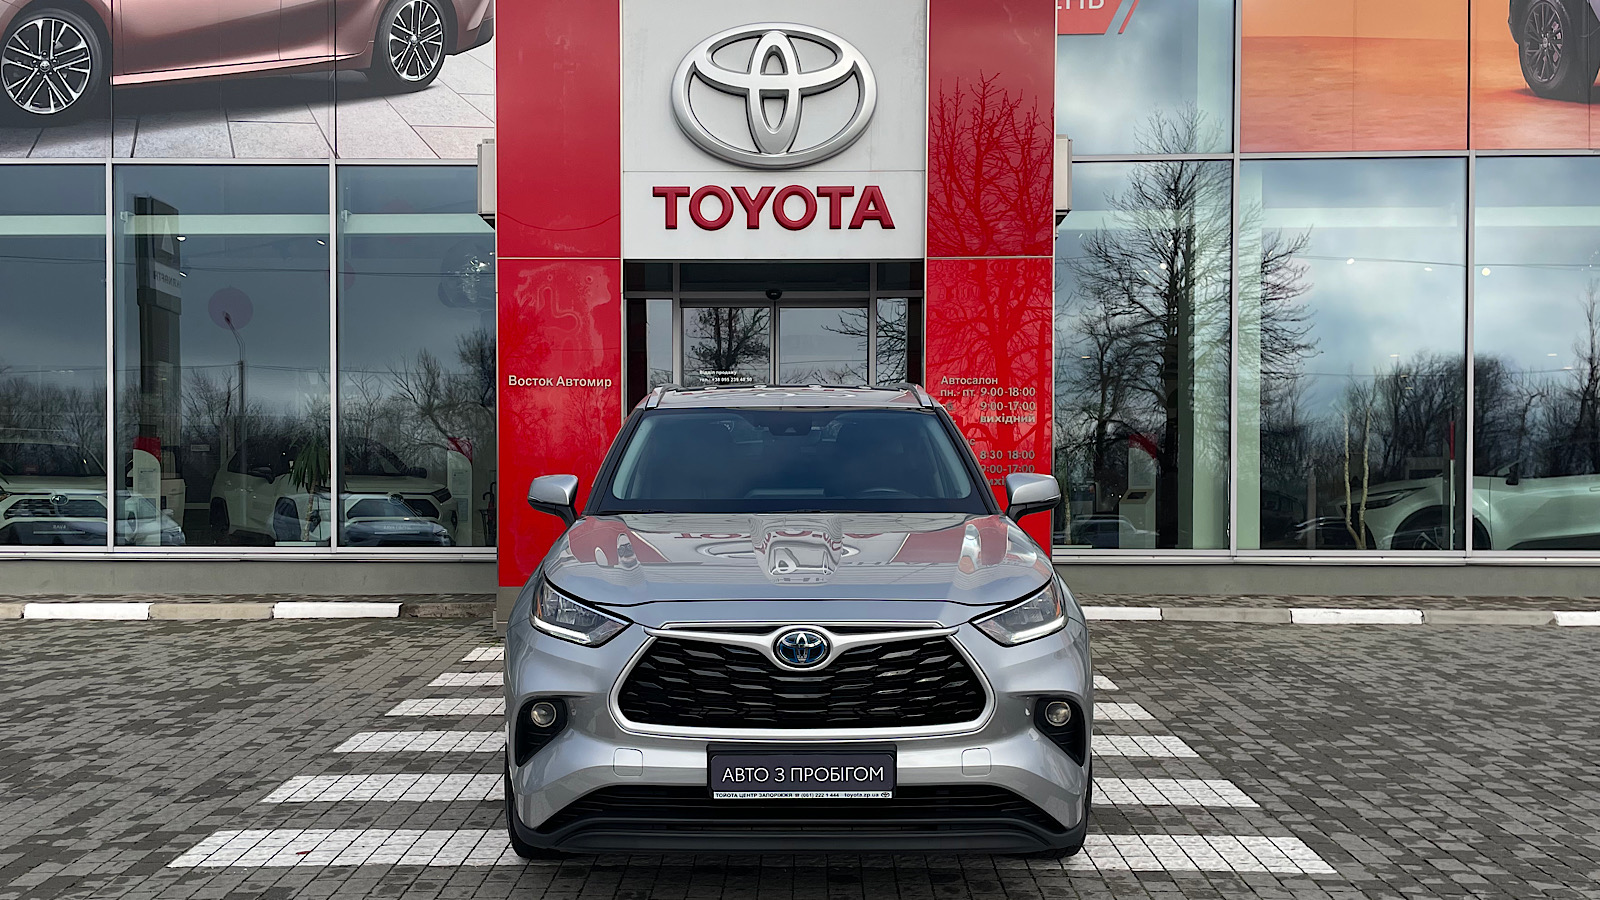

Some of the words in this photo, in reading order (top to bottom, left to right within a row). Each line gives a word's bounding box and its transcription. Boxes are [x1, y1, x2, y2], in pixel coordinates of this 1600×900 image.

[652, 185, 896, 231] TOYOTA
[508, 375, 553, 386] Восток
[556, 376, 612, 389] Автомир
[941, 376, 998, 385] Автосалон
[980, 413, 1036, 424] вихідний
[722, 767, 769, 782] АВТО
[790, 767, 884, 782] ПРОБІГОМ
